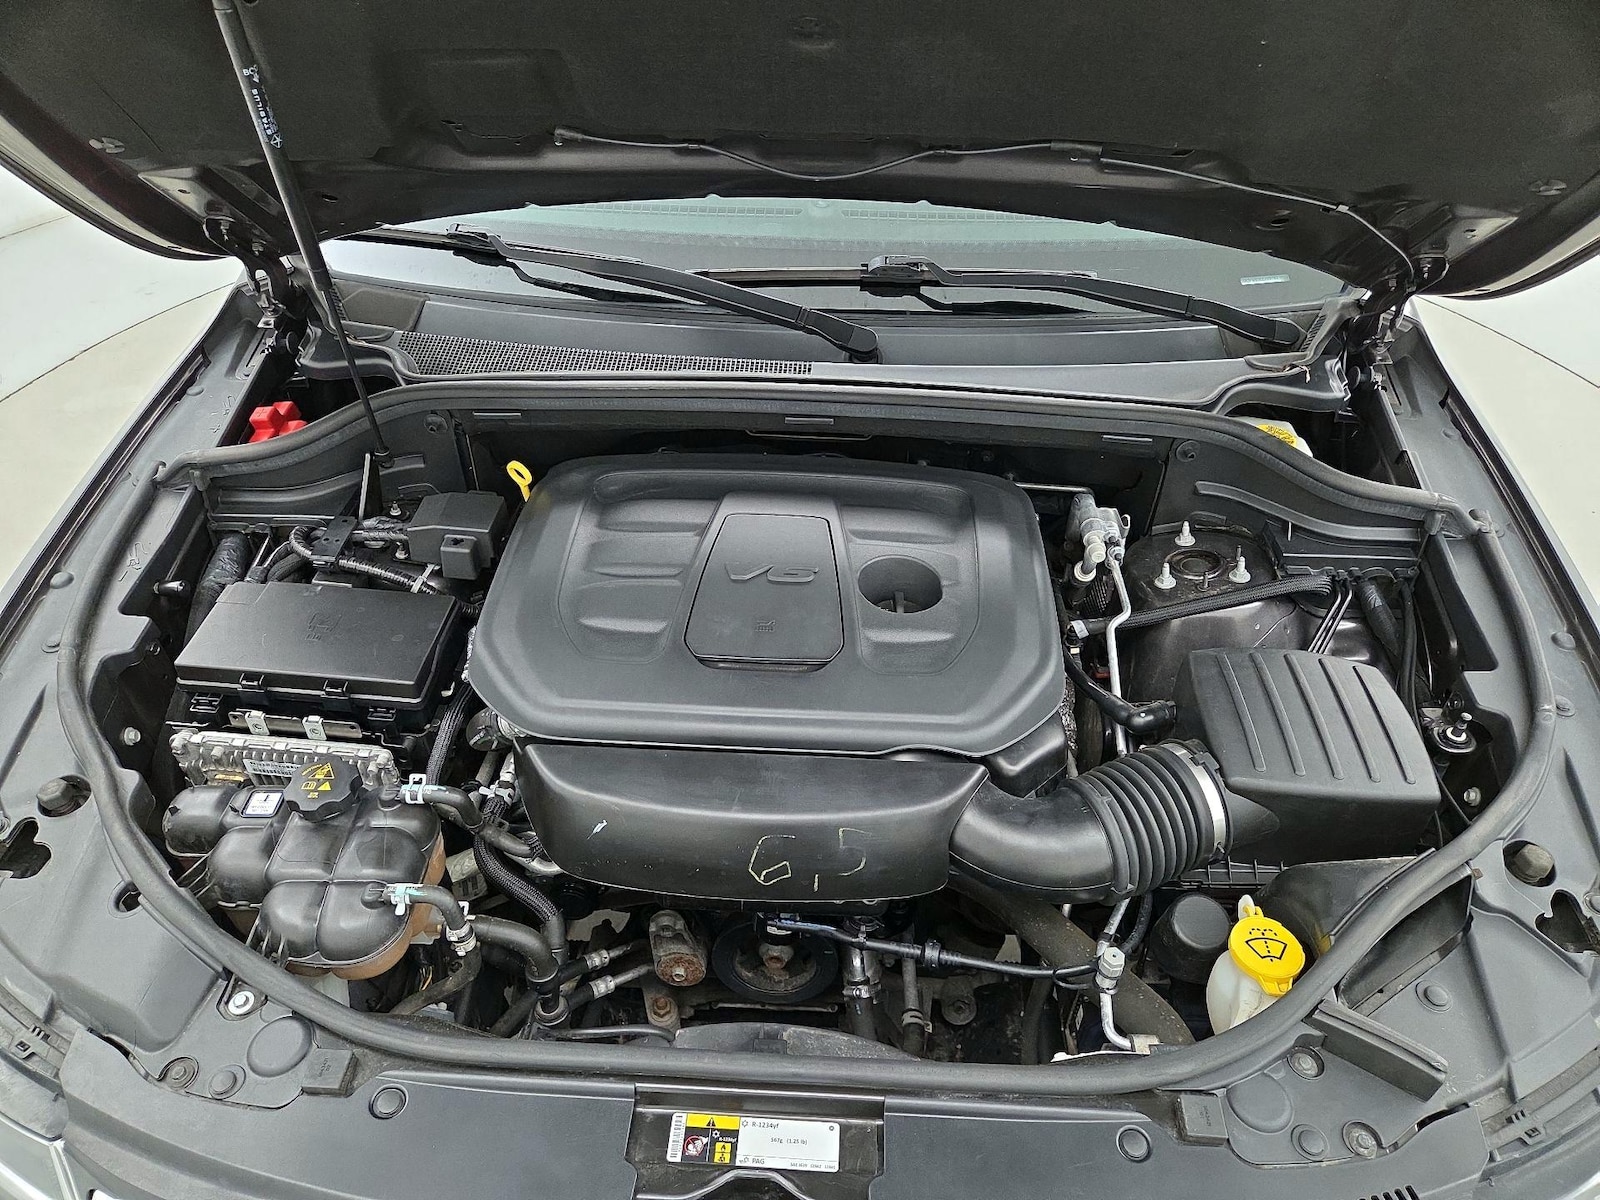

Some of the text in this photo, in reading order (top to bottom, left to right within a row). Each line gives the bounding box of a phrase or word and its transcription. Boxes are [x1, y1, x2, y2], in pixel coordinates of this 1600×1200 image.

[251, 88, 273, 135] STABILUS
[724, 562, 820, 583] V6
[751, 1121, 779, 1130] R-1234yf
[751, 1157, 765, 1165] PAG
